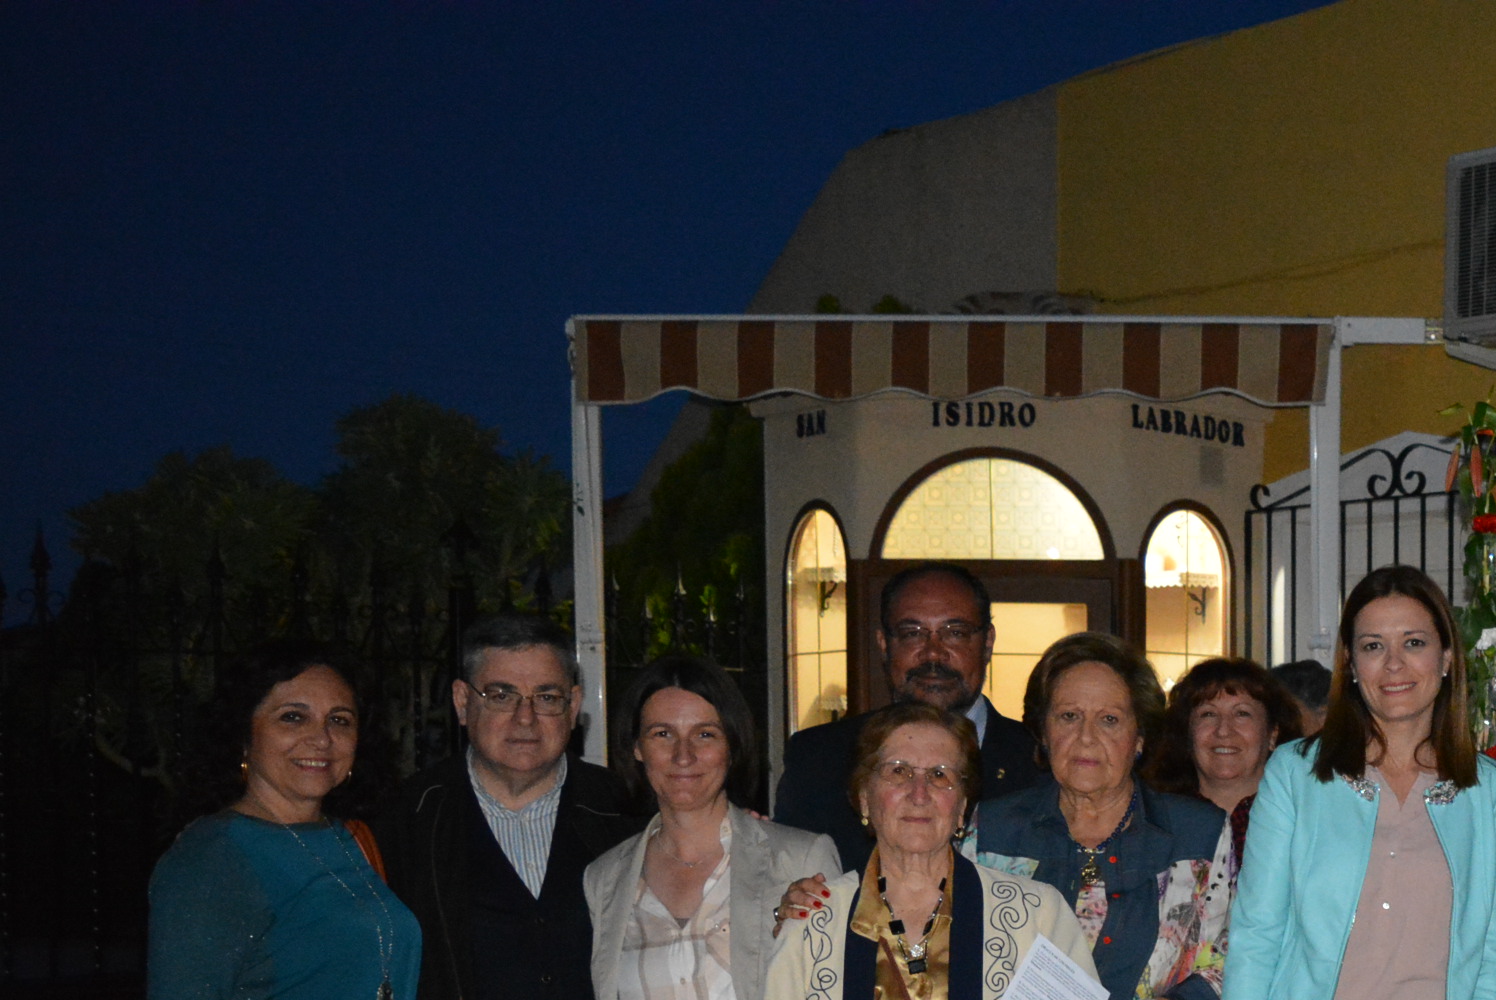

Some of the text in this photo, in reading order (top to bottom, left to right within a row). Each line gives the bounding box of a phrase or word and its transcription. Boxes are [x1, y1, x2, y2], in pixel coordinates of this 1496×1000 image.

[796, 401, 1245, 447] SAN ISIDRO LABRADOR
